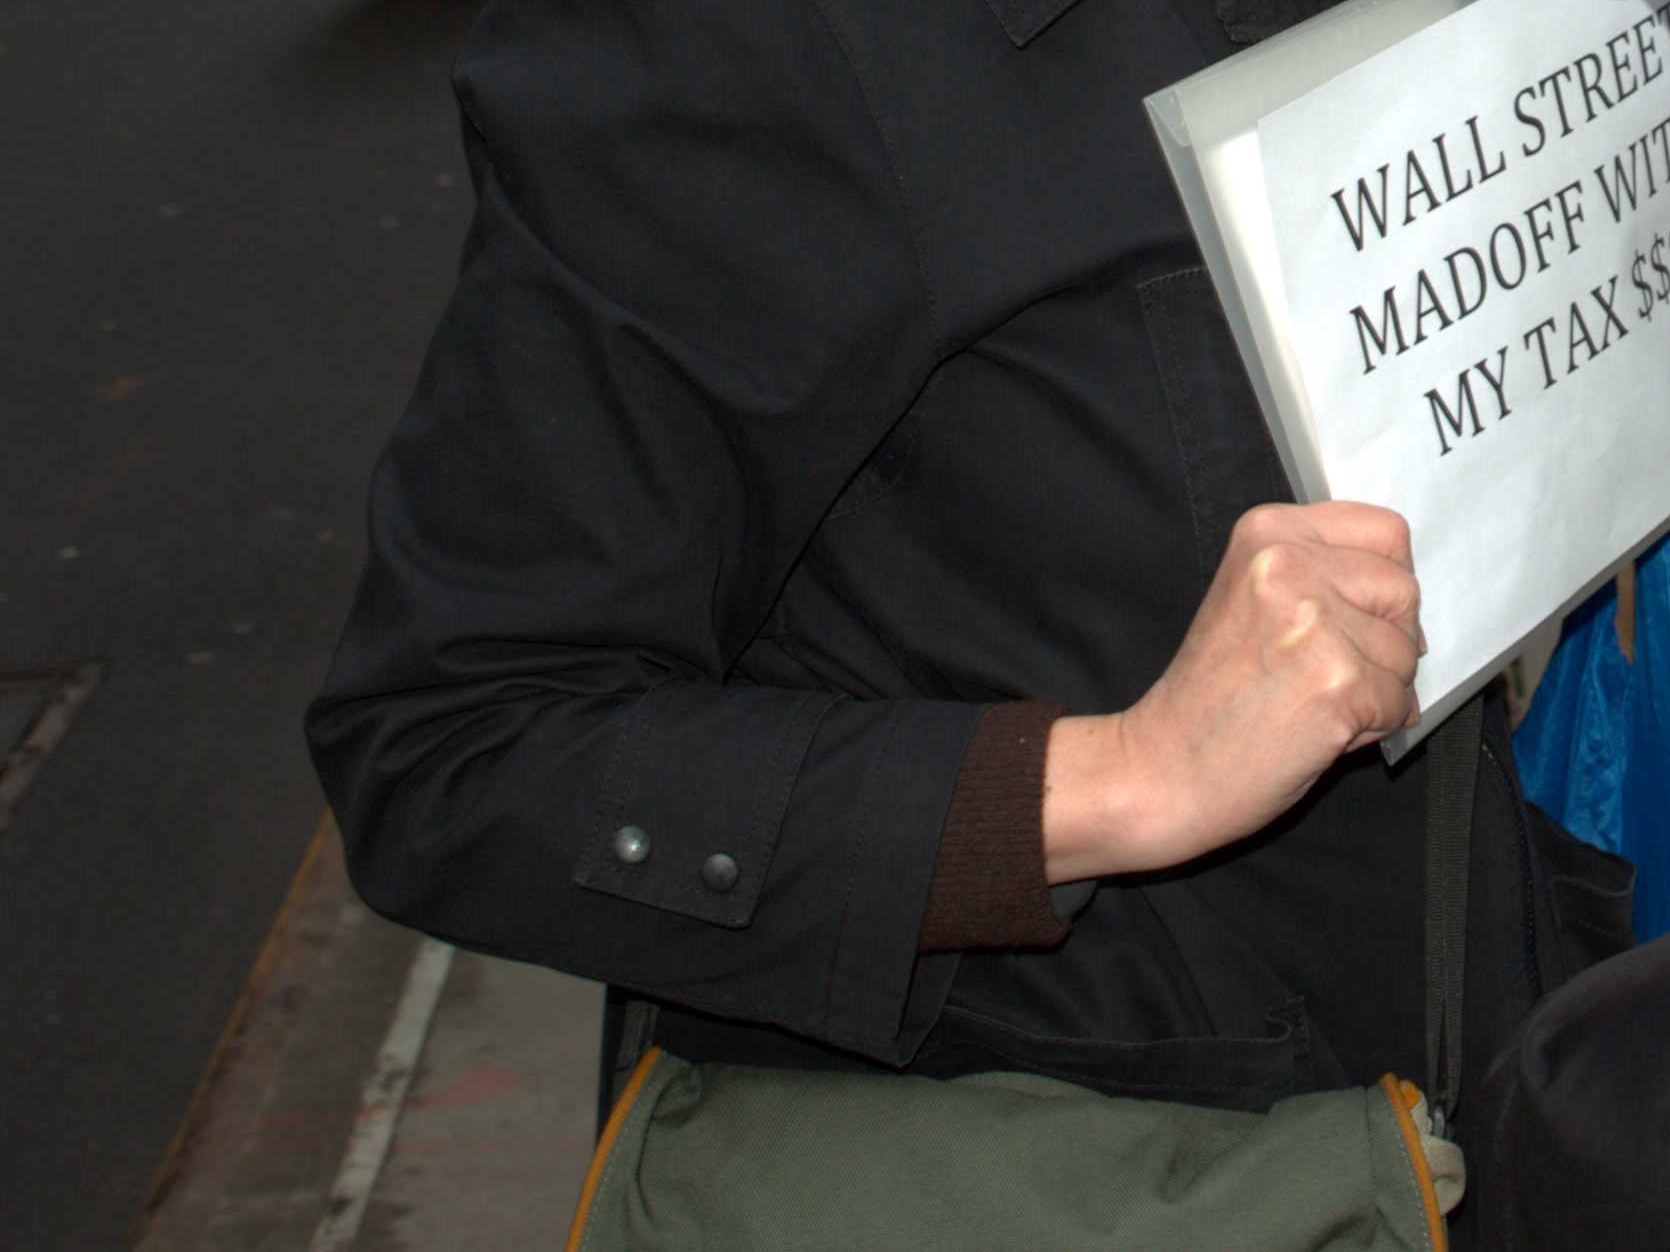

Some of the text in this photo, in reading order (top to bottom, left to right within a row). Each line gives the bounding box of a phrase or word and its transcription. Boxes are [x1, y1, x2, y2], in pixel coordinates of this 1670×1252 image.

[1330, 114, 1508, 253] WALL
[1348, 180, 1586, 375] MADOFF
[1423, 345, 1513, 456] MY
[1523, 275, 1631, 390] TAX
